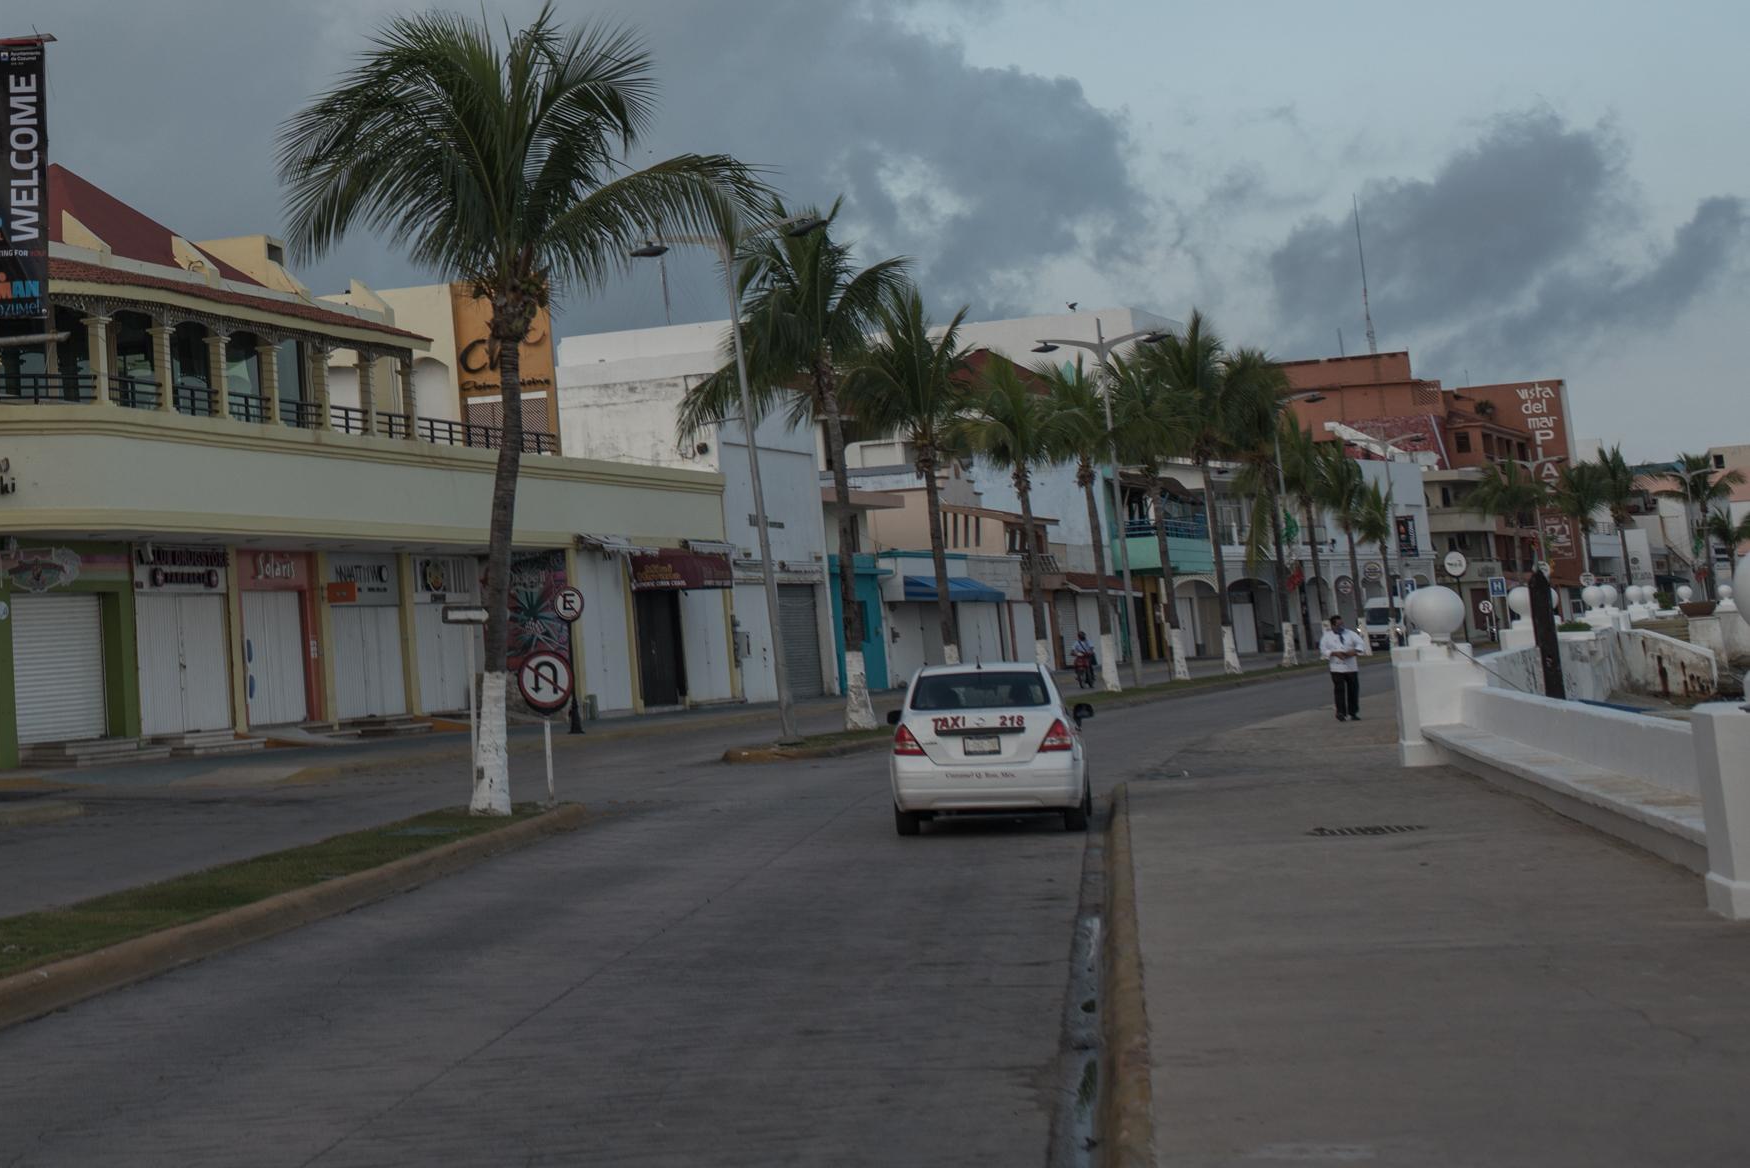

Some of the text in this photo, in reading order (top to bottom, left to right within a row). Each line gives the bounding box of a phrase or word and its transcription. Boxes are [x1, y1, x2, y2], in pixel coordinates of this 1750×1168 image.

[8, 73, 40, 243] WELCOME
[14, 249, 28, 257] FOR
[1522, 399, 1547, 415] del
[1527, 416, 1559, 430] mar
[257, 552, 297, 580] Solaris
[1492, 579, 1504, 592] H
[562, 592, 576, 611] E
[932, 715, 1024, 730] TAXI 218
